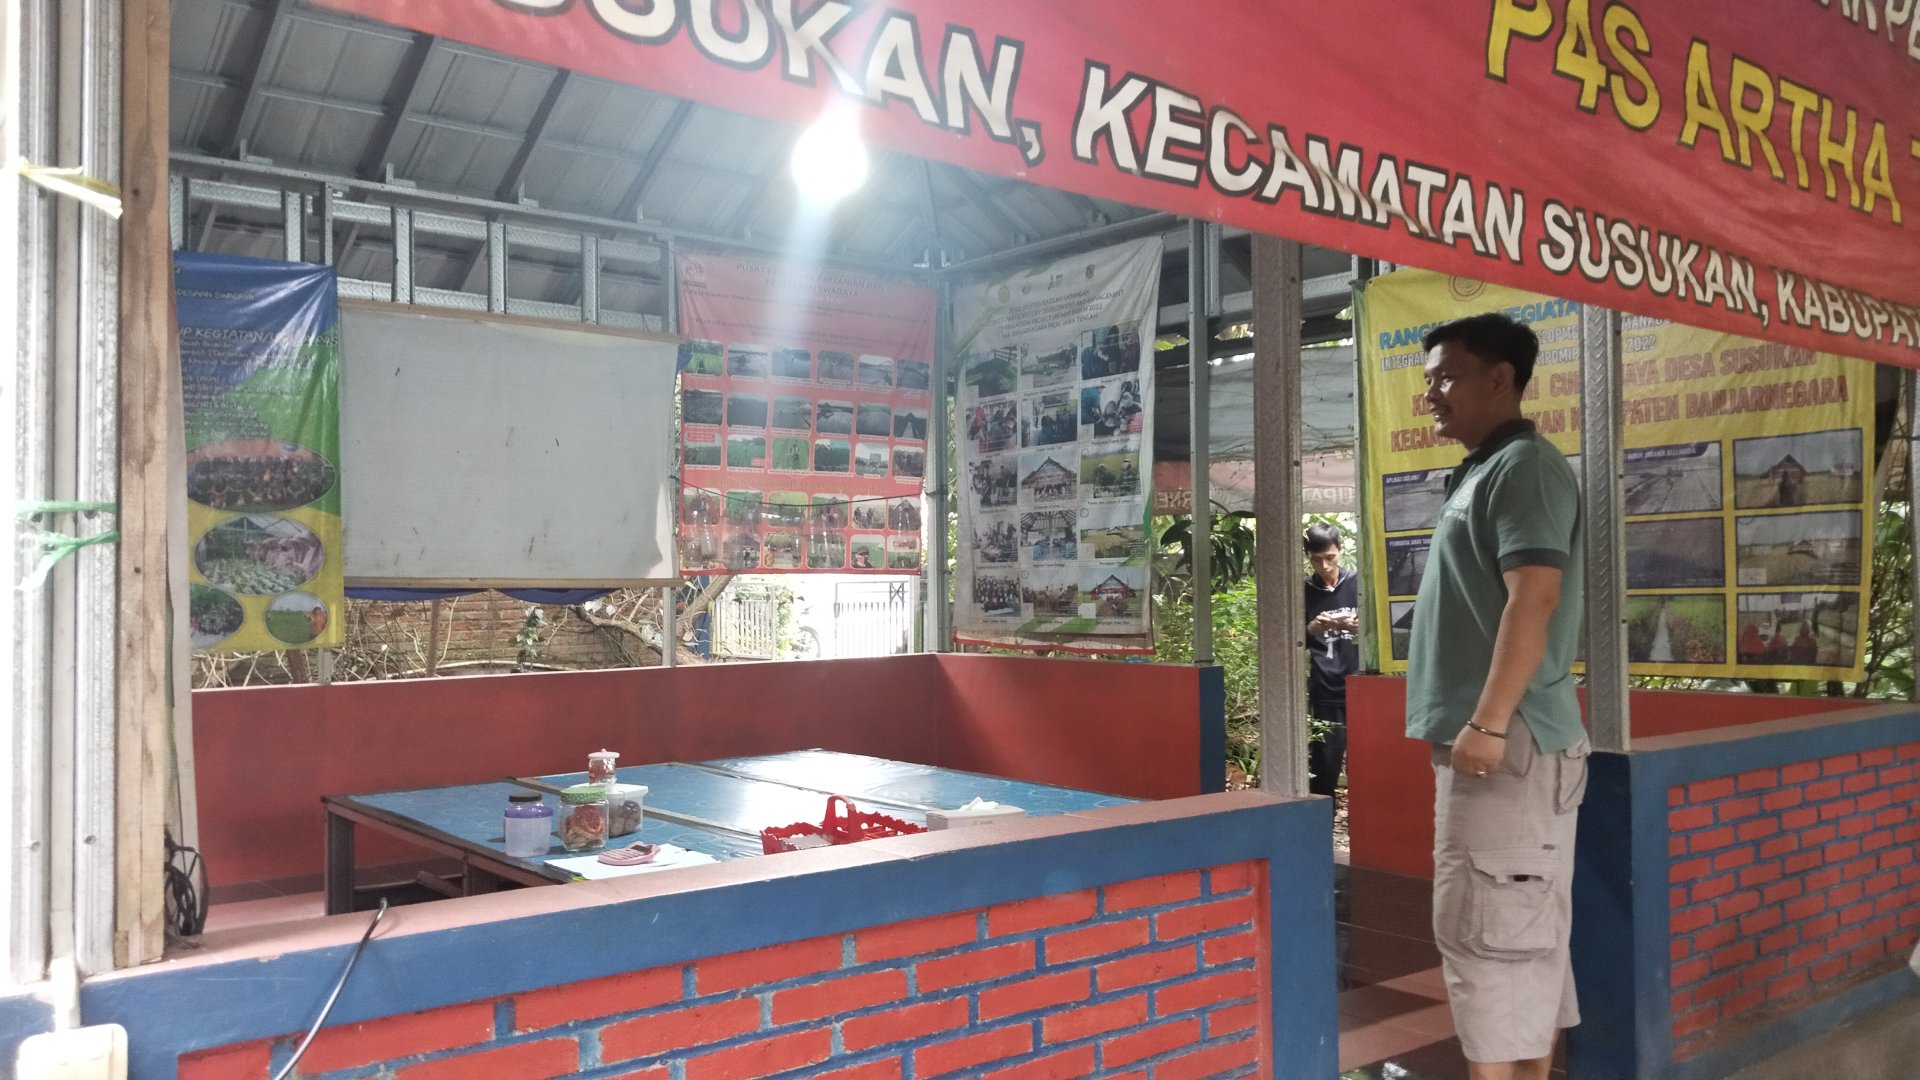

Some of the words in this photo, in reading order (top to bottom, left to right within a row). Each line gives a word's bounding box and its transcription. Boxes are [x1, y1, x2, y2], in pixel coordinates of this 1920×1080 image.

[1486, 0, 1660, 131] P4S
[1679, 40, 1902, 225] ARTHA
[1074, 59, 1524, 262] KECAMATAN
[1539, 200, 1770, 328] SUSUKAN,
[1626, 335, 1657, 353] 2022
[1665, 351, 1716, 383] DESA
[1685, 375, 1848, 419] BANJARNEGARA
